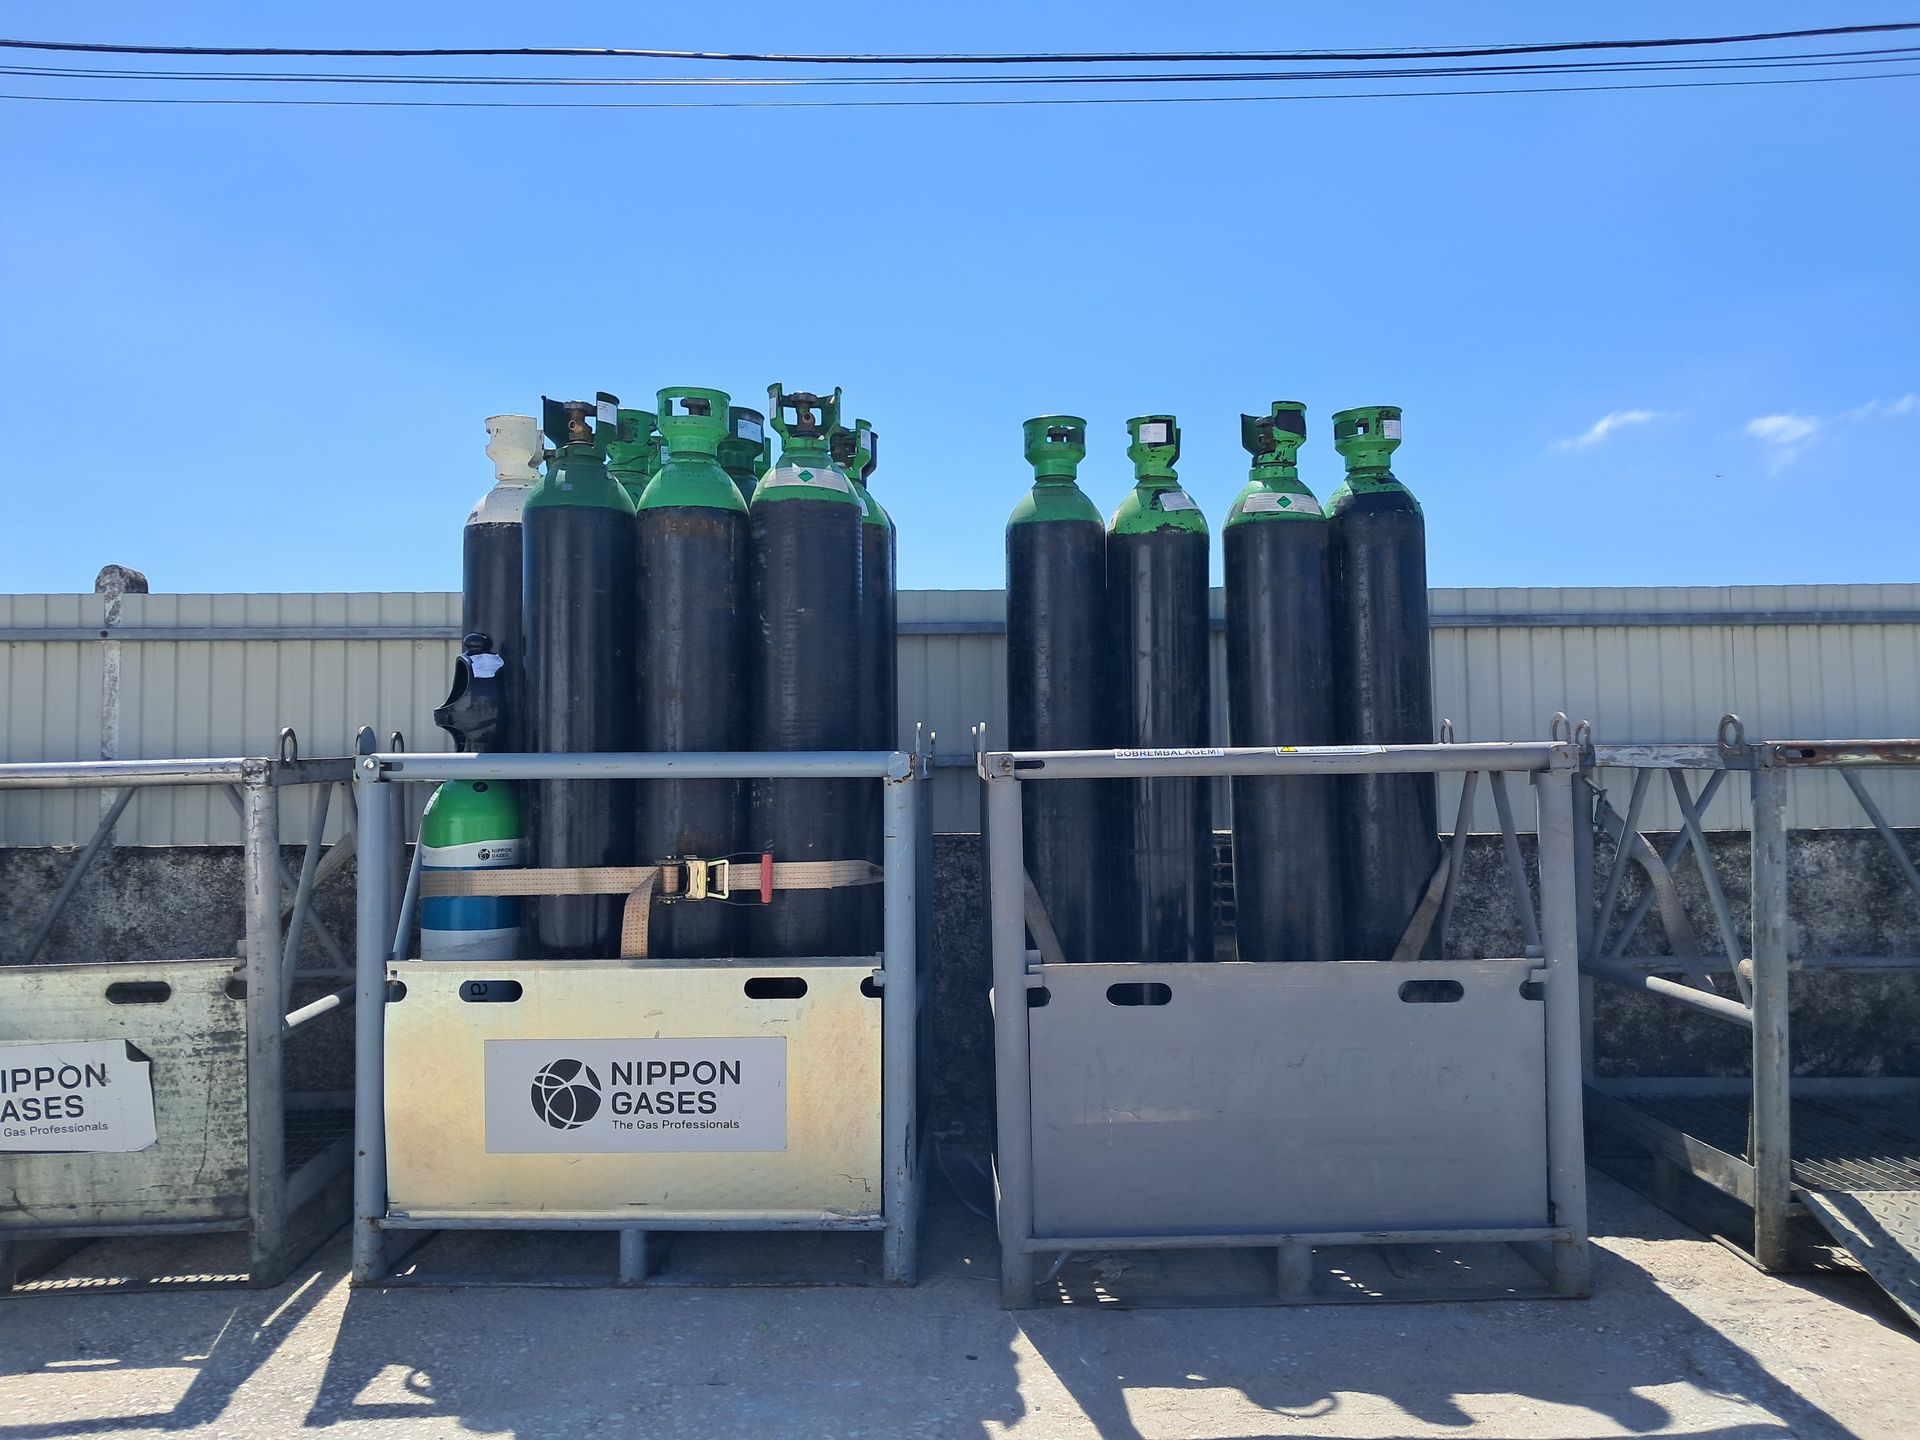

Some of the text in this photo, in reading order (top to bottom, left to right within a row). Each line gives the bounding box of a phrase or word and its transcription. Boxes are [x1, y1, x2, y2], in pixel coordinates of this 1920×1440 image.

[0, 1063, 106, 1093] IPPON
[611, 1061, 741, 1086] NIPPON
[0, 1094, 84, 1123] ASES
[611, 1091, 717, 1115] GASES
[3, 1121, 109, 1138] Gas Professionals
[612, 1119, 740, 1130] The Gas Professionals
